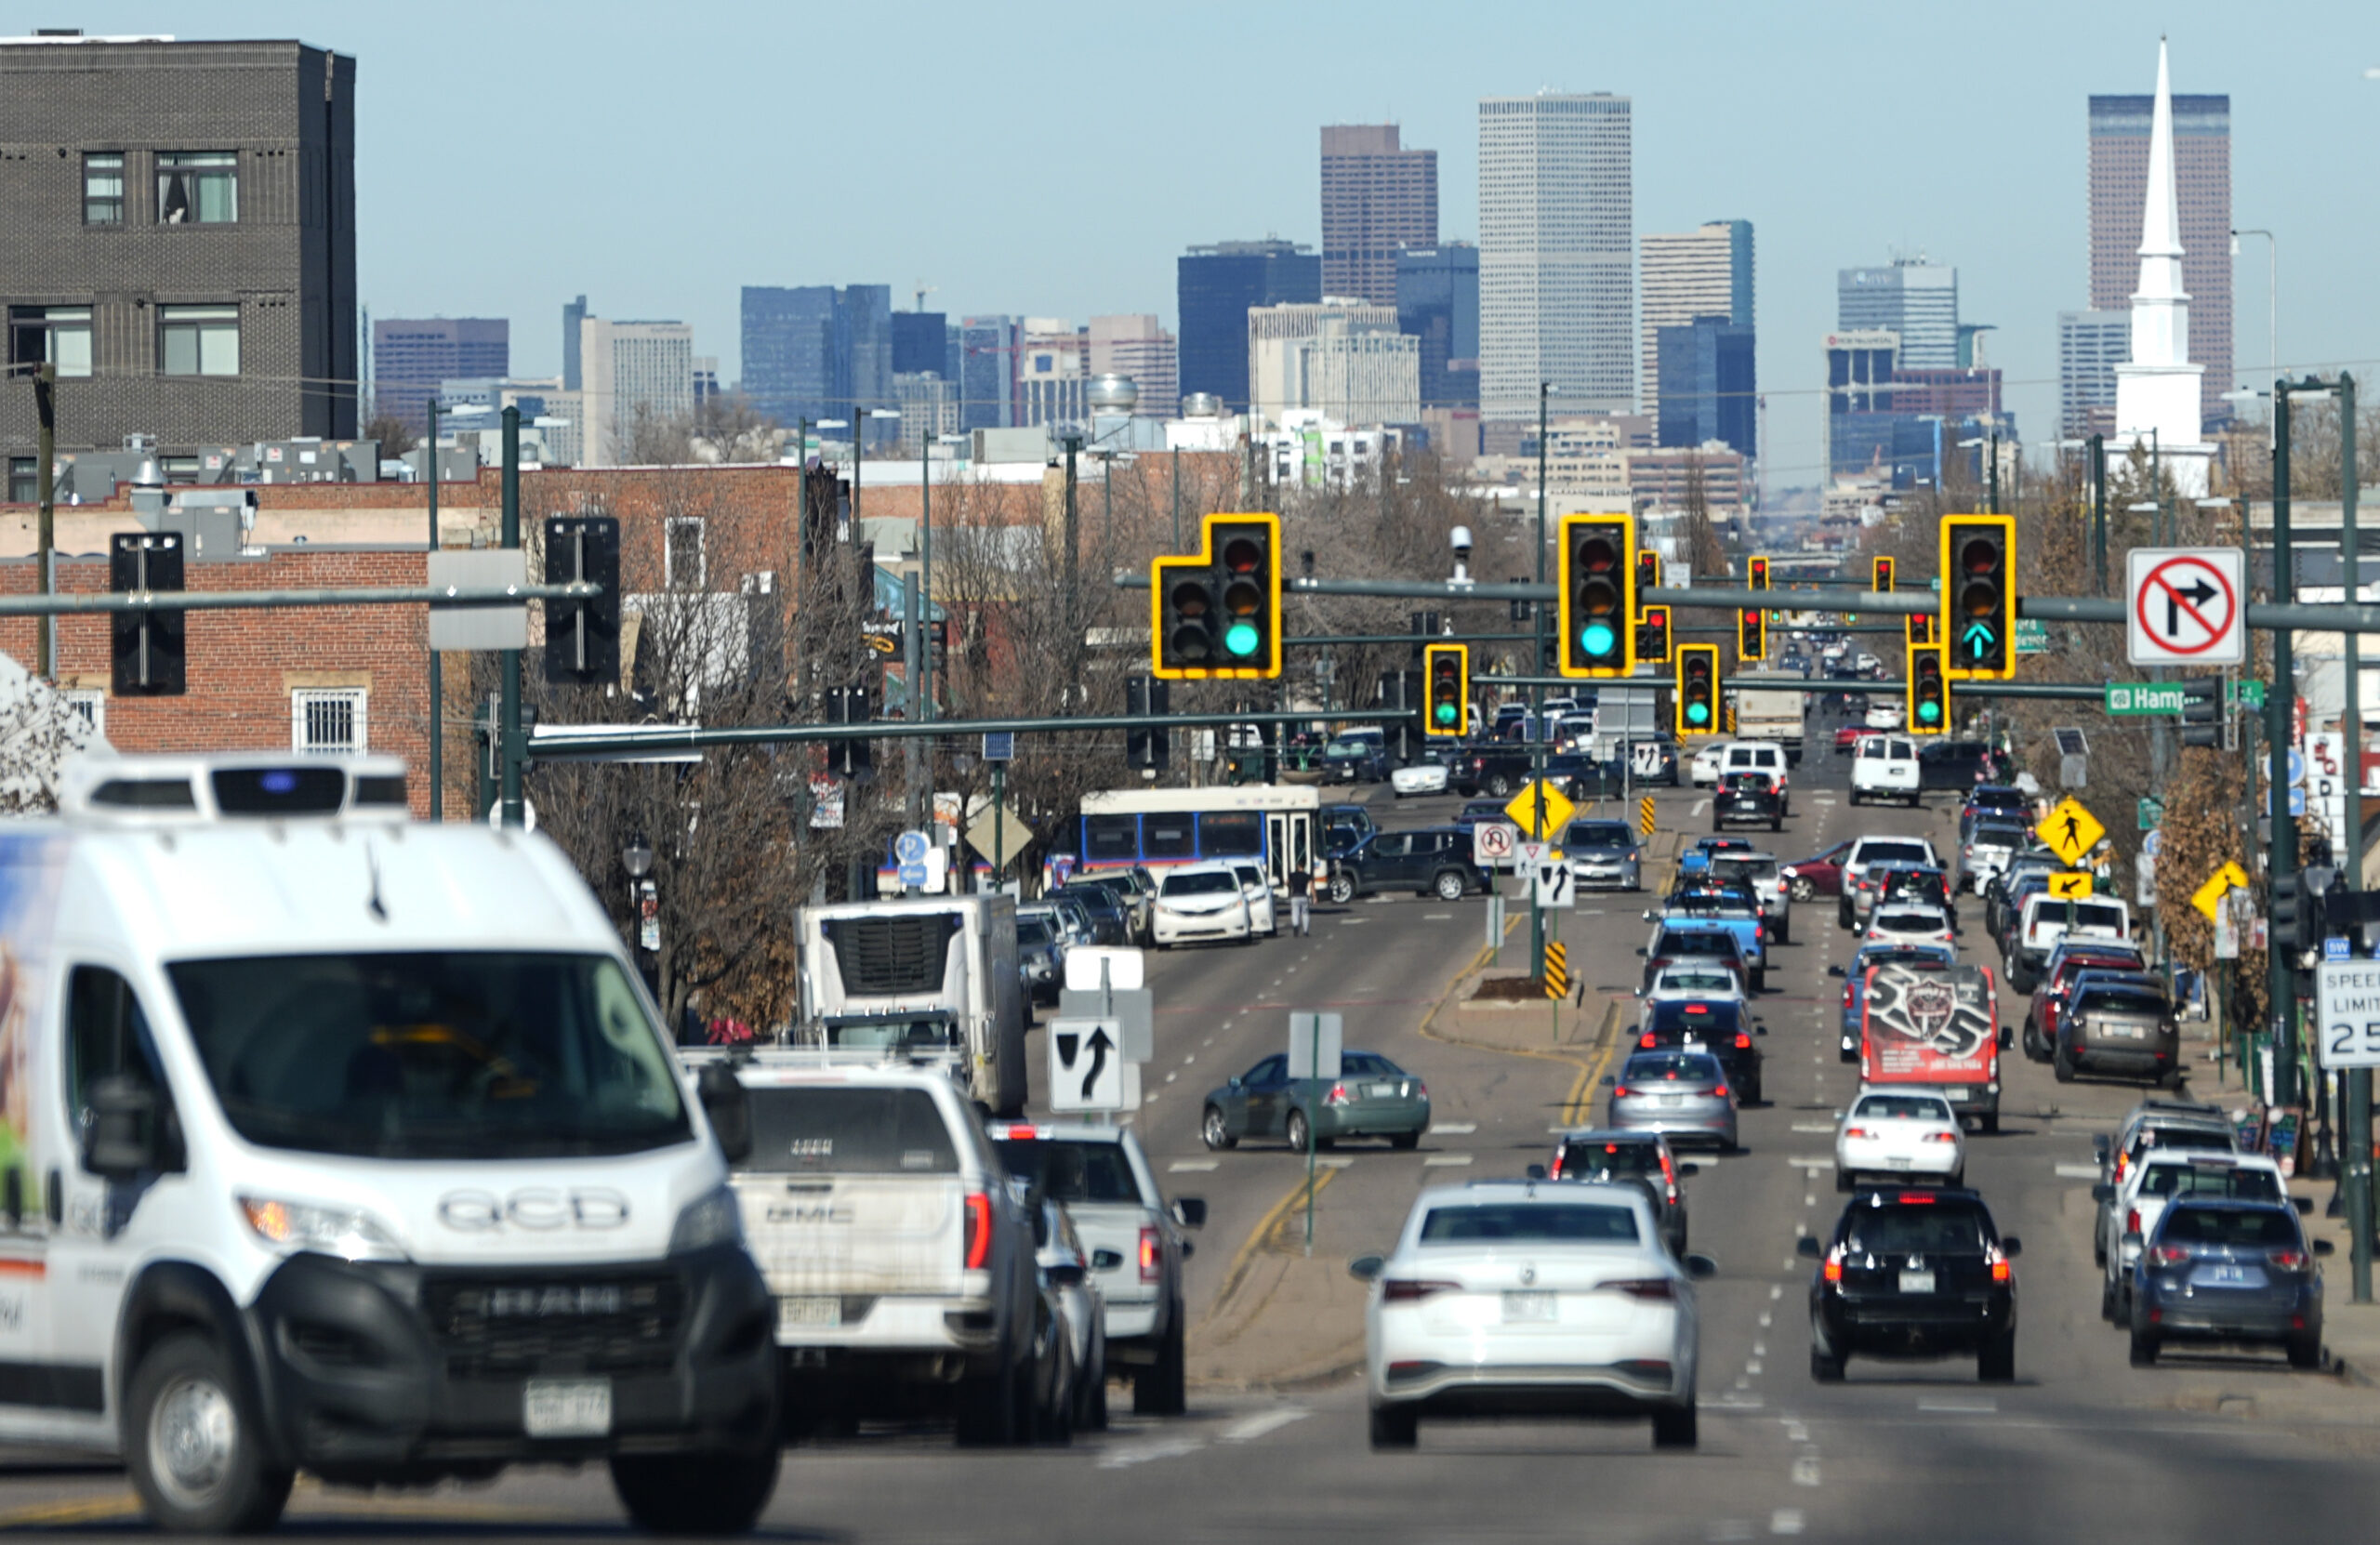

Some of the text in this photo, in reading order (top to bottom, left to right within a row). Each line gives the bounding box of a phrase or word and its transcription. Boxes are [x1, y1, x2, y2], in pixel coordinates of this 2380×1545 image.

[2326, 972, 2380, 989] SPEE
[2330, 1023, 2380, 1054] 25
[437, 1187, 631, 1235] QCD
[766, 1203, 854, 1223] GMC
